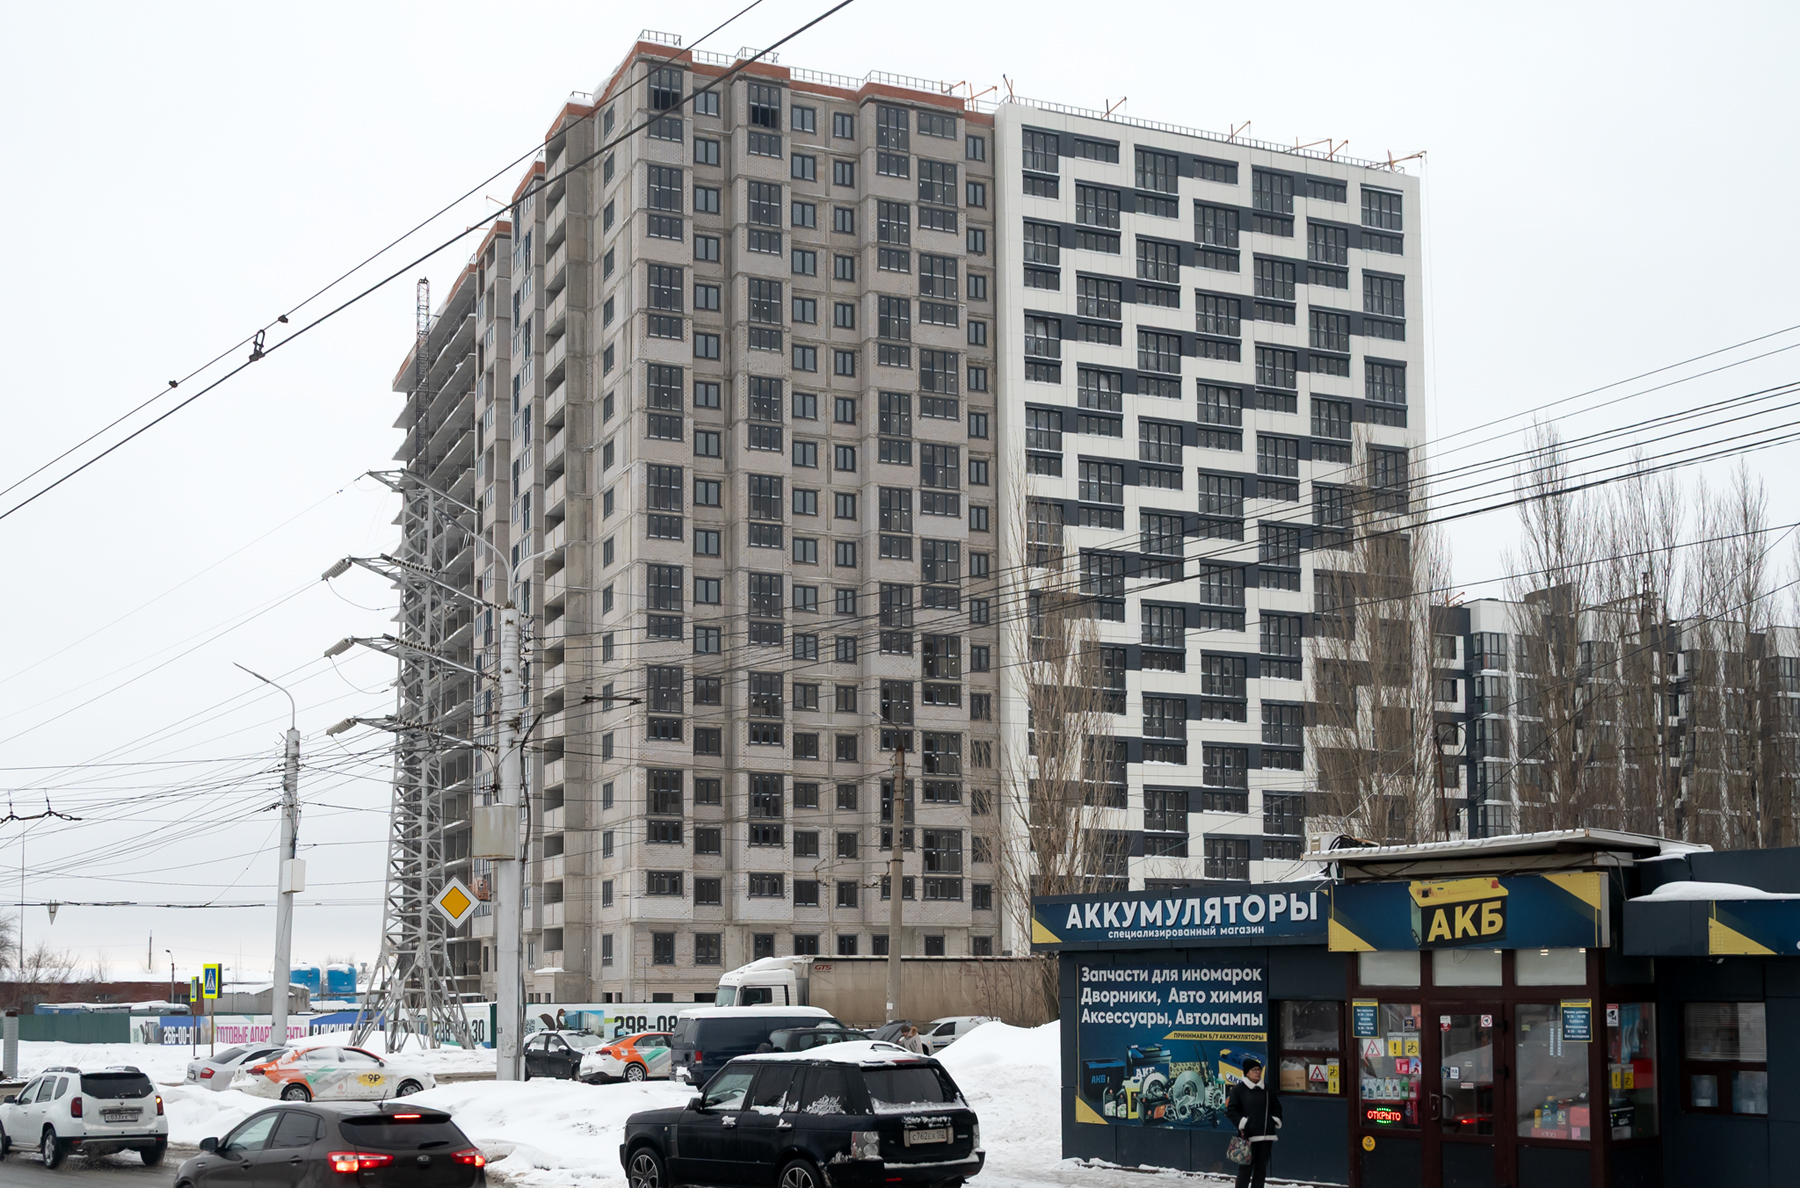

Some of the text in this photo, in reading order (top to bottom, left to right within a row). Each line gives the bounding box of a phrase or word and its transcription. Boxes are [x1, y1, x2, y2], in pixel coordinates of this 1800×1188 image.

[1065, 891, 1318, 930] АККУМУЛЯТОРЫ
[1427, 900, 1504, 942] АКБ
[1108, 925, 1265, 939] специализированный магазин
[1081, 966, 1262, 986] Запчасти для иномарок
[1081, 987, 1263, 1007] Дворники, Авто химия
[1081, 1008, 1263, 1029] Аксессуары, Автолампы
[216, 1026, 249, 1044] ГОТОВЫЕ
[1219, 1033, 1264, 1041] АККУМУЛЯТОРЫ
[1367, 1109, 1402, 1122] ОТКРЫТО
